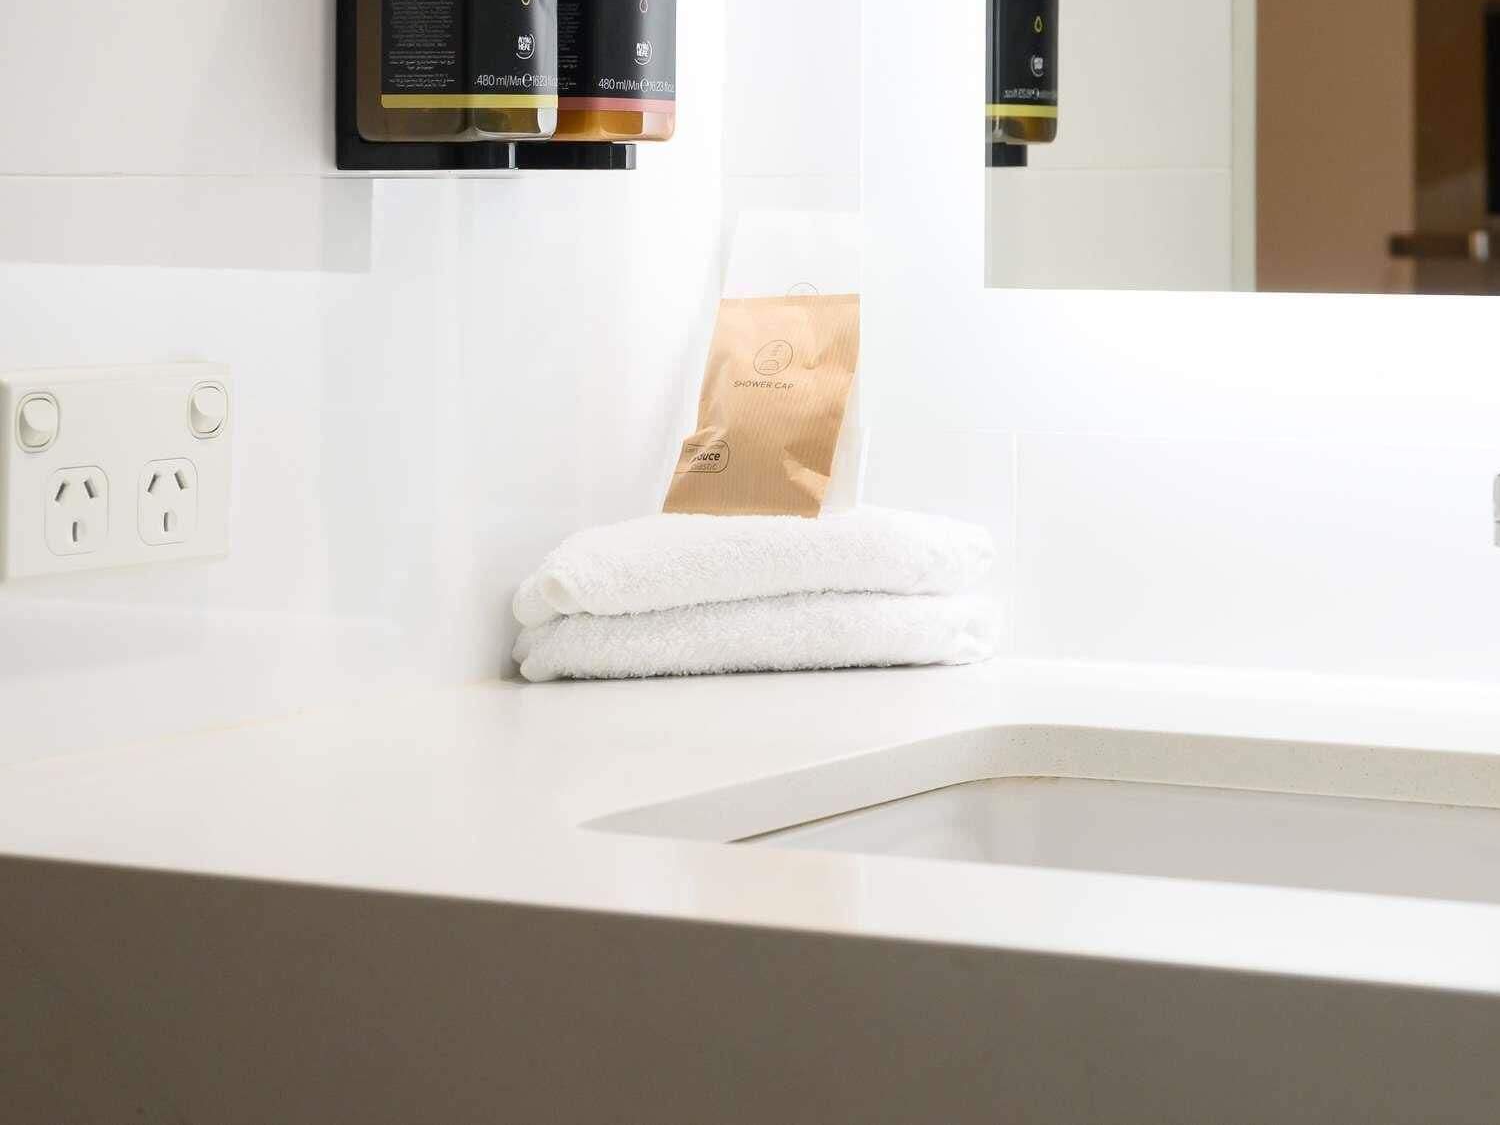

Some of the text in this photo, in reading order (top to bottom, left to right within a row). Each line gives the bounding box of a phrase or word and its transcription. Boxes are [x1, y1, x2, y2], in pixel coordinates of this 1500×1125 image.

[476, 75, 496, 87] 480
[599, 78, 616, 90] 480
[733, 379, 795, 391] SHOWER CAP
